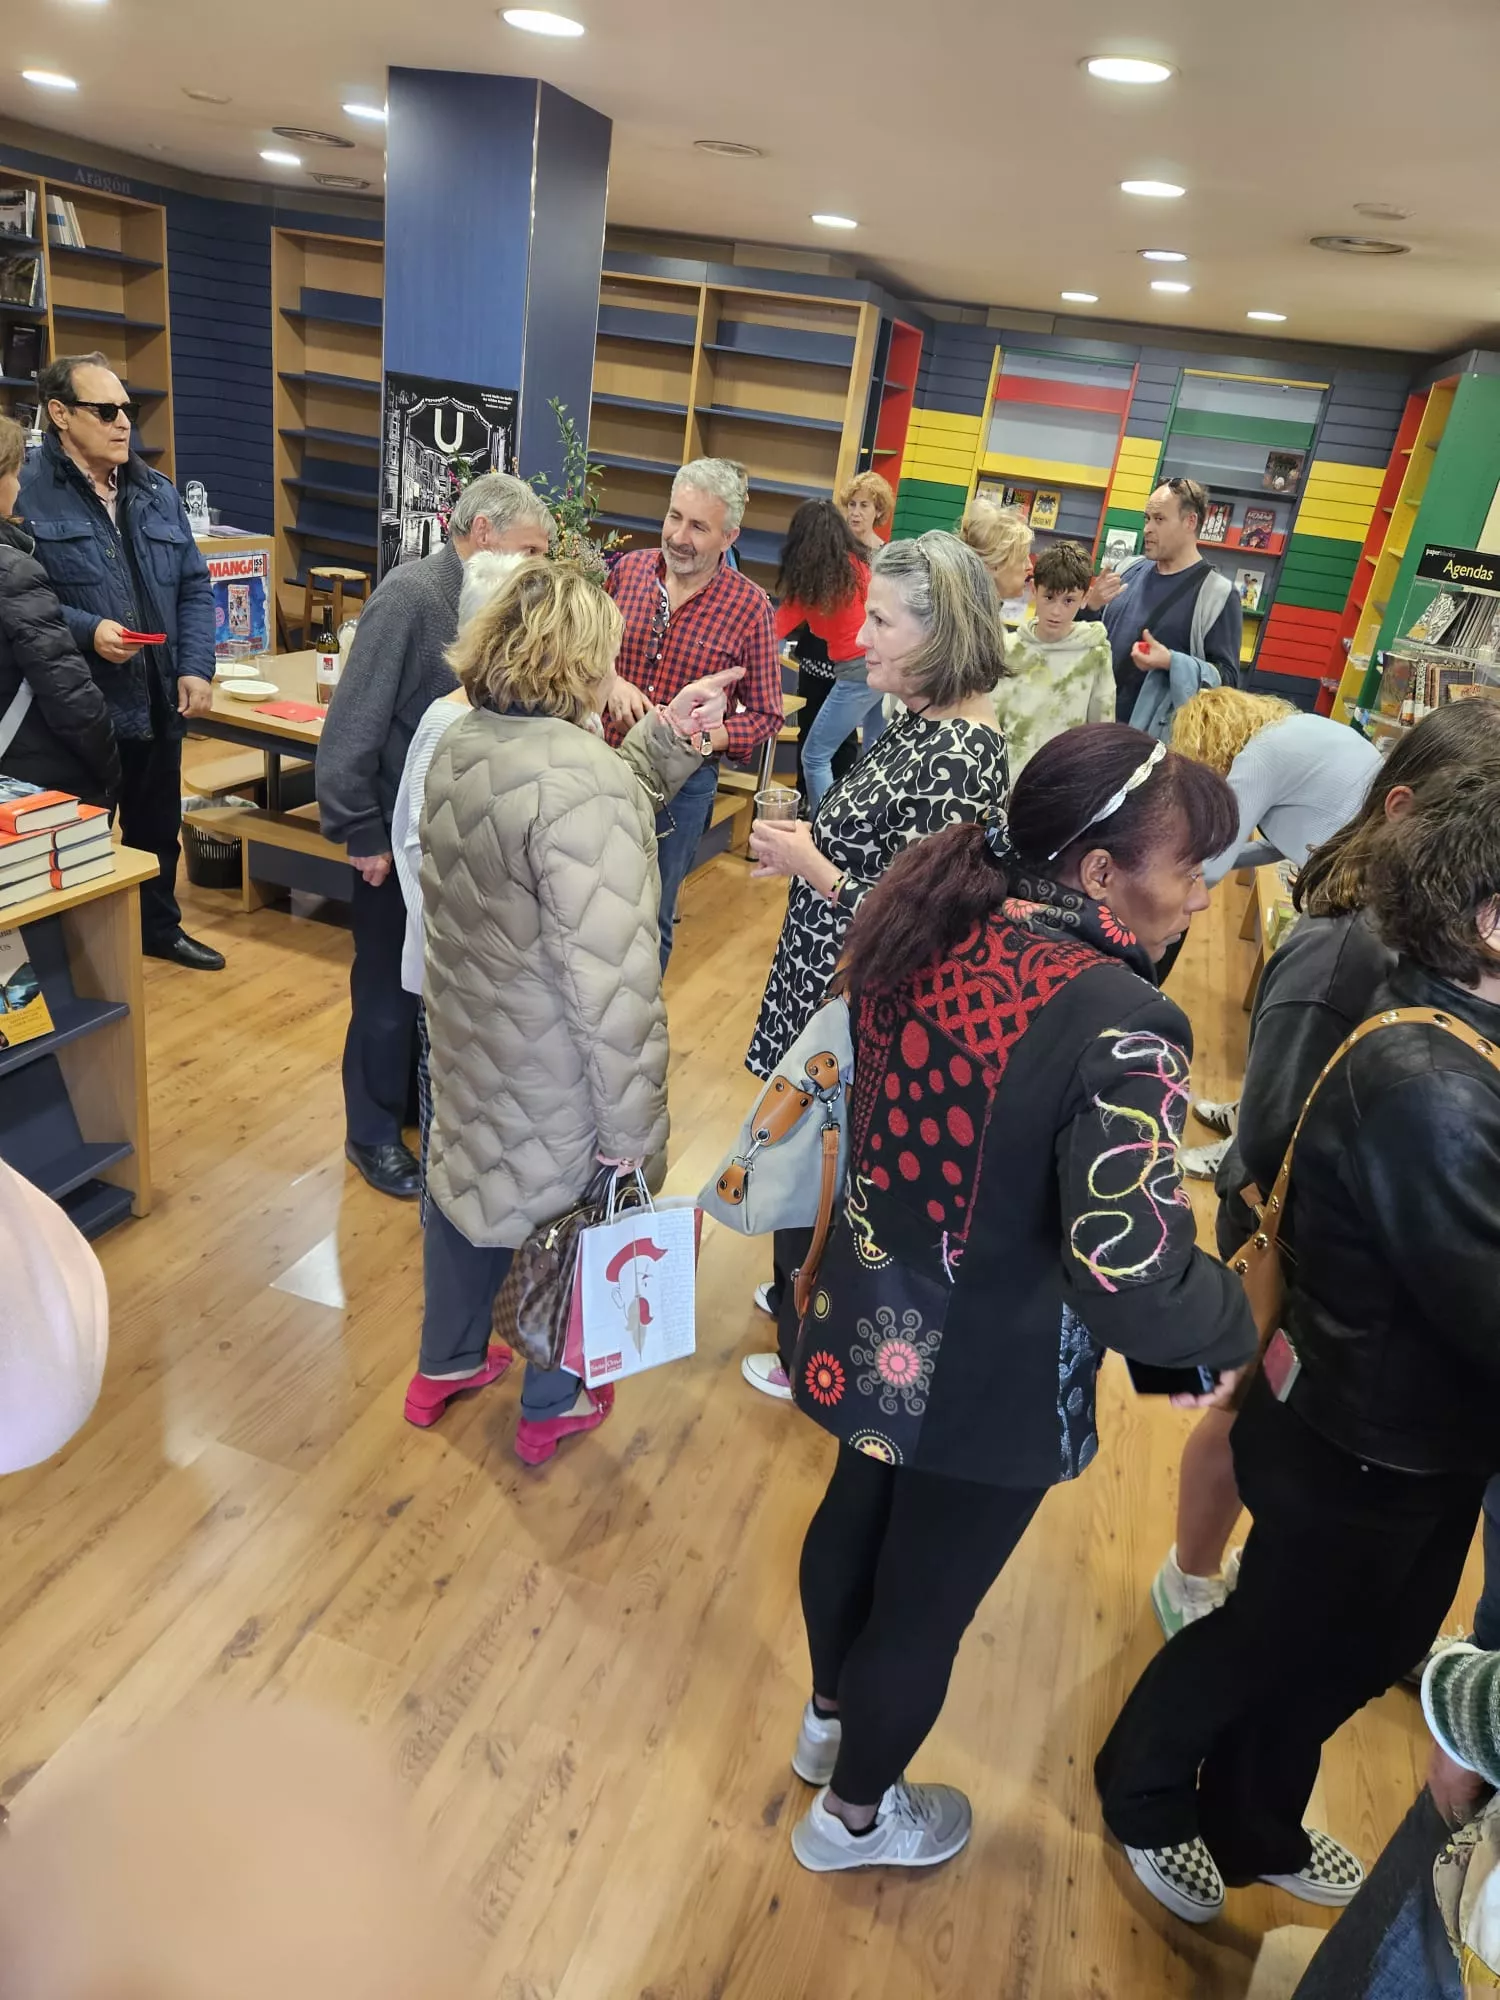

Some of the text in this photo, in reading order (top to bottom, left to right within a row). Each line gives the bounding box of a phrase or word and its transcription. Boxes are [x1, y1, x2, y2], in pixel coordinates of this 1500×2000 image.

[74, 168, 131, 194] Aragón
[434, 408, 464, 453] U
[208, 559, 253, 577] MANGA
[1443, 559, 1494, 580] Agendas
